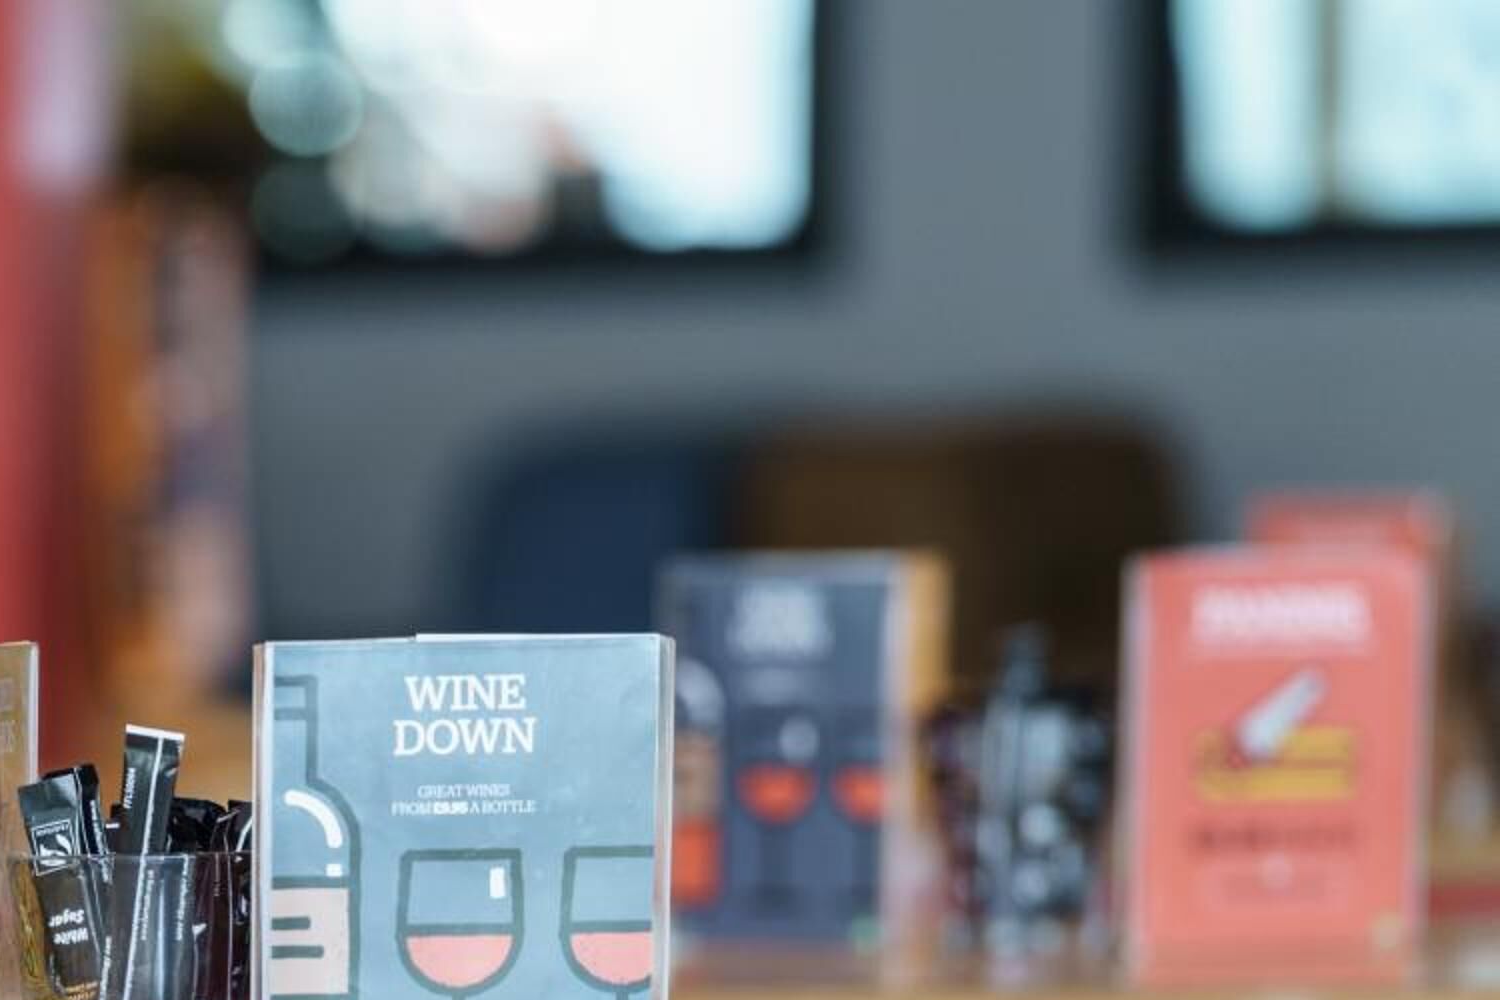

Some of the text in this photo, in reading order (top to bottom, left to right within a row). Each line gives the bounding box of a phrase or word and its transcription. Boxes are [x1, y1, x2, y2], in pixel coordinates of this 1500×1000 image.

[404, 673, 526, 713] WINE
[393, 716, 538, 756] DOWN
[417, 783, 511, 799] GREAT WINES
[391, 801, 432, 816] FROM
[469, 801, 481, 814] A
[482, 799, 536, 814] BOTTLE
[48, 908, 85, 928] Sugar
[53, 927, 89, 945] White
